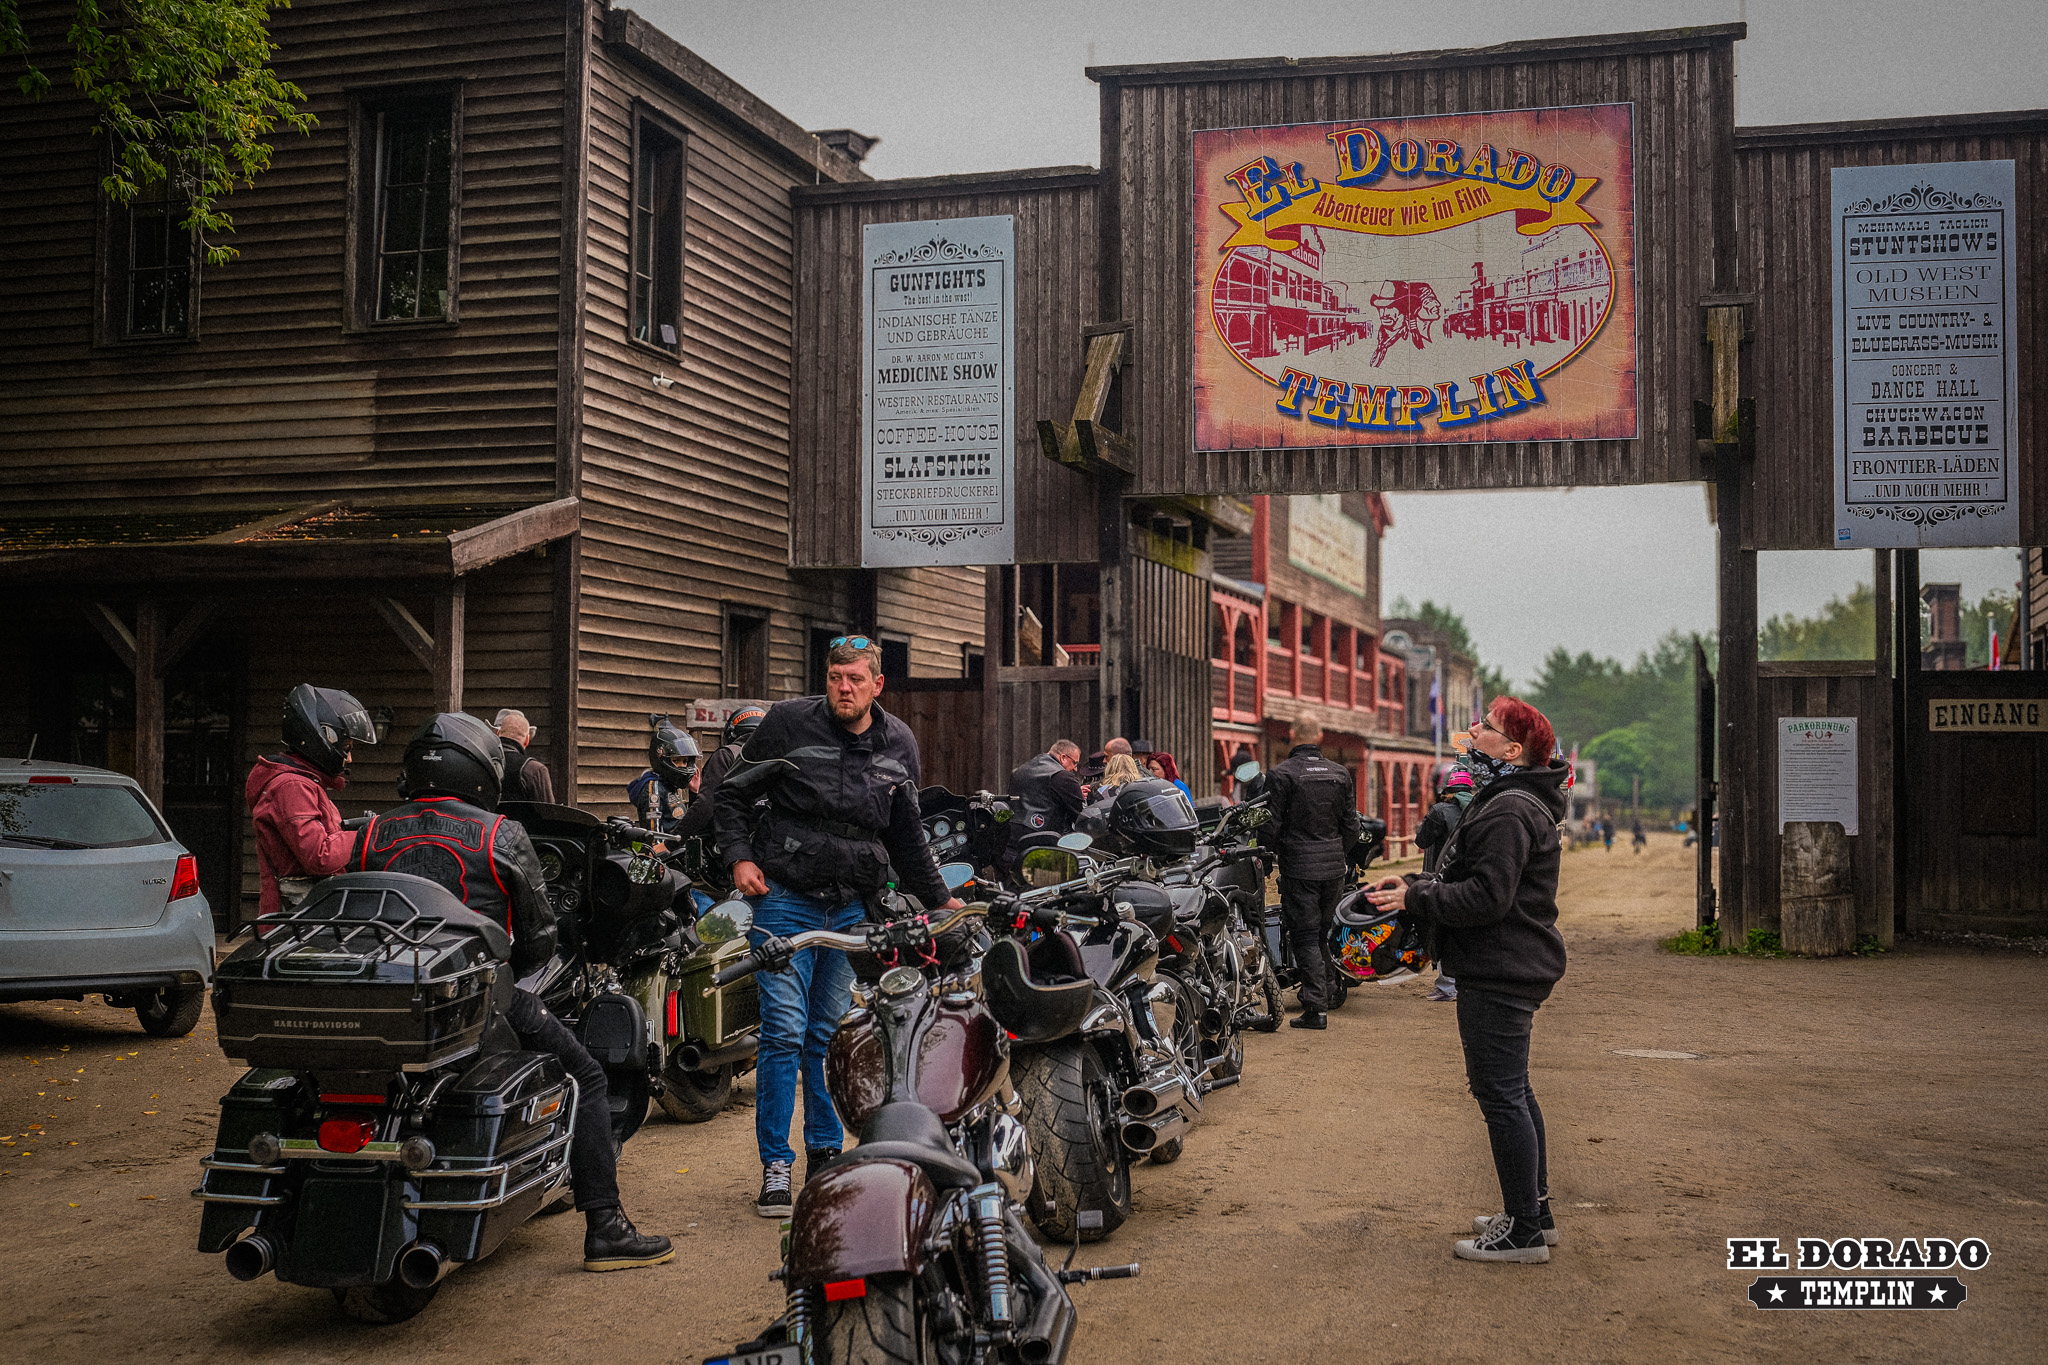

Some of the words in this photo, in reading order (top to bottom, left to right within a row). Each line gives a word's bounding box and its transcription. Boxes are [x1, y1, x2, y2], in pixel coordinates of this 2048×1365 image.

[1327, 128, 1576, 202] DORADO
[1312, 191, 1394, 227] Abenteuer
[1401, 198, 1428, 226] wie
[1431, 196, 1450, 221] im
[1458, 185, 1492, 216] Film
[1858, 221, 1930, 233] MEHRMALS
[1940, 217, 1988, 230] TÄGLICH
[1850, 232, 1997, 256] STUNTSHOWS
[890, 269, 986, 292] GUNFIGHTS
[1856, 268, 1908, 284] OLD
[1917, 265, 1991, 281] WEST
[904, 295, 915, 305] The
[918, 294, 931, 304] best
[933, 294, 939, 303] in
[942, 293, 952, 303] the
[1868, 284, 1980, 302] MUSEEN
[878, 313, 957, 328] INDIANISCHE
[960, 309, 998, 324] TÄNZE
[1857, 315, 1891, 330] LIVE
[1899, 312, 1975, 329] COUNTRY-
[1983, 313, 1994, 326] &
[887, 331, 914, 343] UND
[917, 325, 989, 341] GEBRÄUCHE
[1852, 333, 1998, 353] BLUEGRASS-MUSIK
[892, 355, 903, 364] DR.
[905, 355, 915, 363] W.
[878, 365, 948, 384] MEDICINE
[953, 363, 998, 380] SHOW
[1892, 364, 1941, 377] CONCERT
[1950, 363, 1958, 374] &
[1276, 359, 1547, 431] TEMPLIN
[1871, 381, 1925, 399] DANCE
[1937, 379, 1979, 397] HALL
[878, 396, 925, 408] WESTERN
[927, 392, 999, 406] RESTAURANTS
[877, 424, 998, 445] COFFEE-HOUSE
[1863, 424, 1988, 447] BARBECUE
[885, 453, 991, 478] SLAPSTICK
[1852, 455, 1999, 475] FRONTIER-LÄDEN
[877, 485, 998, 501] STECKBRIEFDRUCKEREI
[1905, 483, 1939, 497] NOCH
[1943, 483, 1980, 496] MEHR
[920, 508, 948, 521] NOCH
[952, 507, 982, 520] MEHR
[1935, 703, 2040, 727] EINGANG
[1787, 721, 1850, 733] PARKORDNUNG
